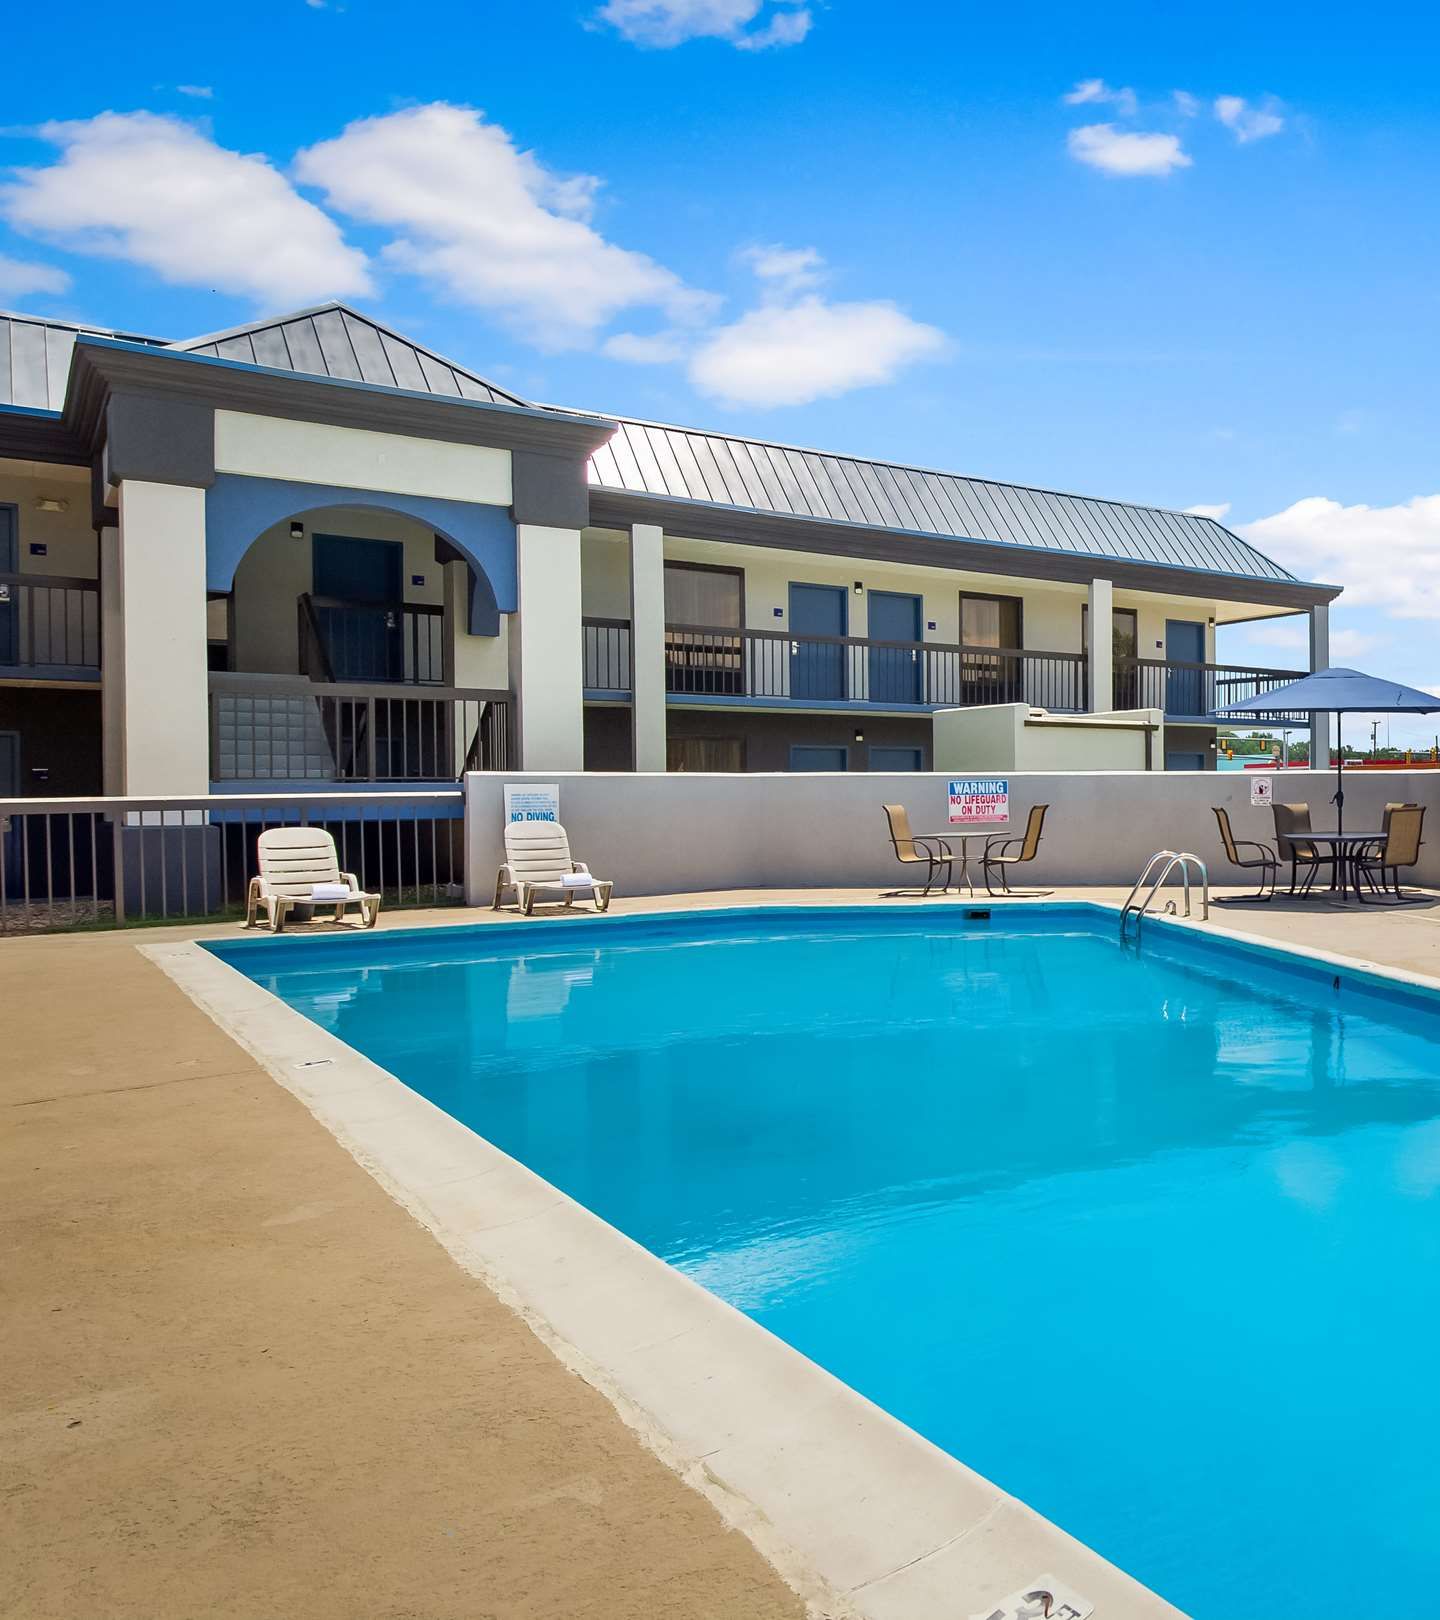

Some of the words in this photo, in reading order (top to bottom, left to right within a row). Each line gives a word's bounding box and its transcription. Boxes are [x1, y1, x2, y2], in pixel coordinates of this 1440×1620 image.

[954, 782, 1004, 794] WARNING
[951, 796, 961, 805] NO
[965, 795, 1006, 804] LIFEGUARD
[962, 806, 972, 814] ON
[976, 805, 996, 814] DUTY
[511, 812, 523, 822] NO
